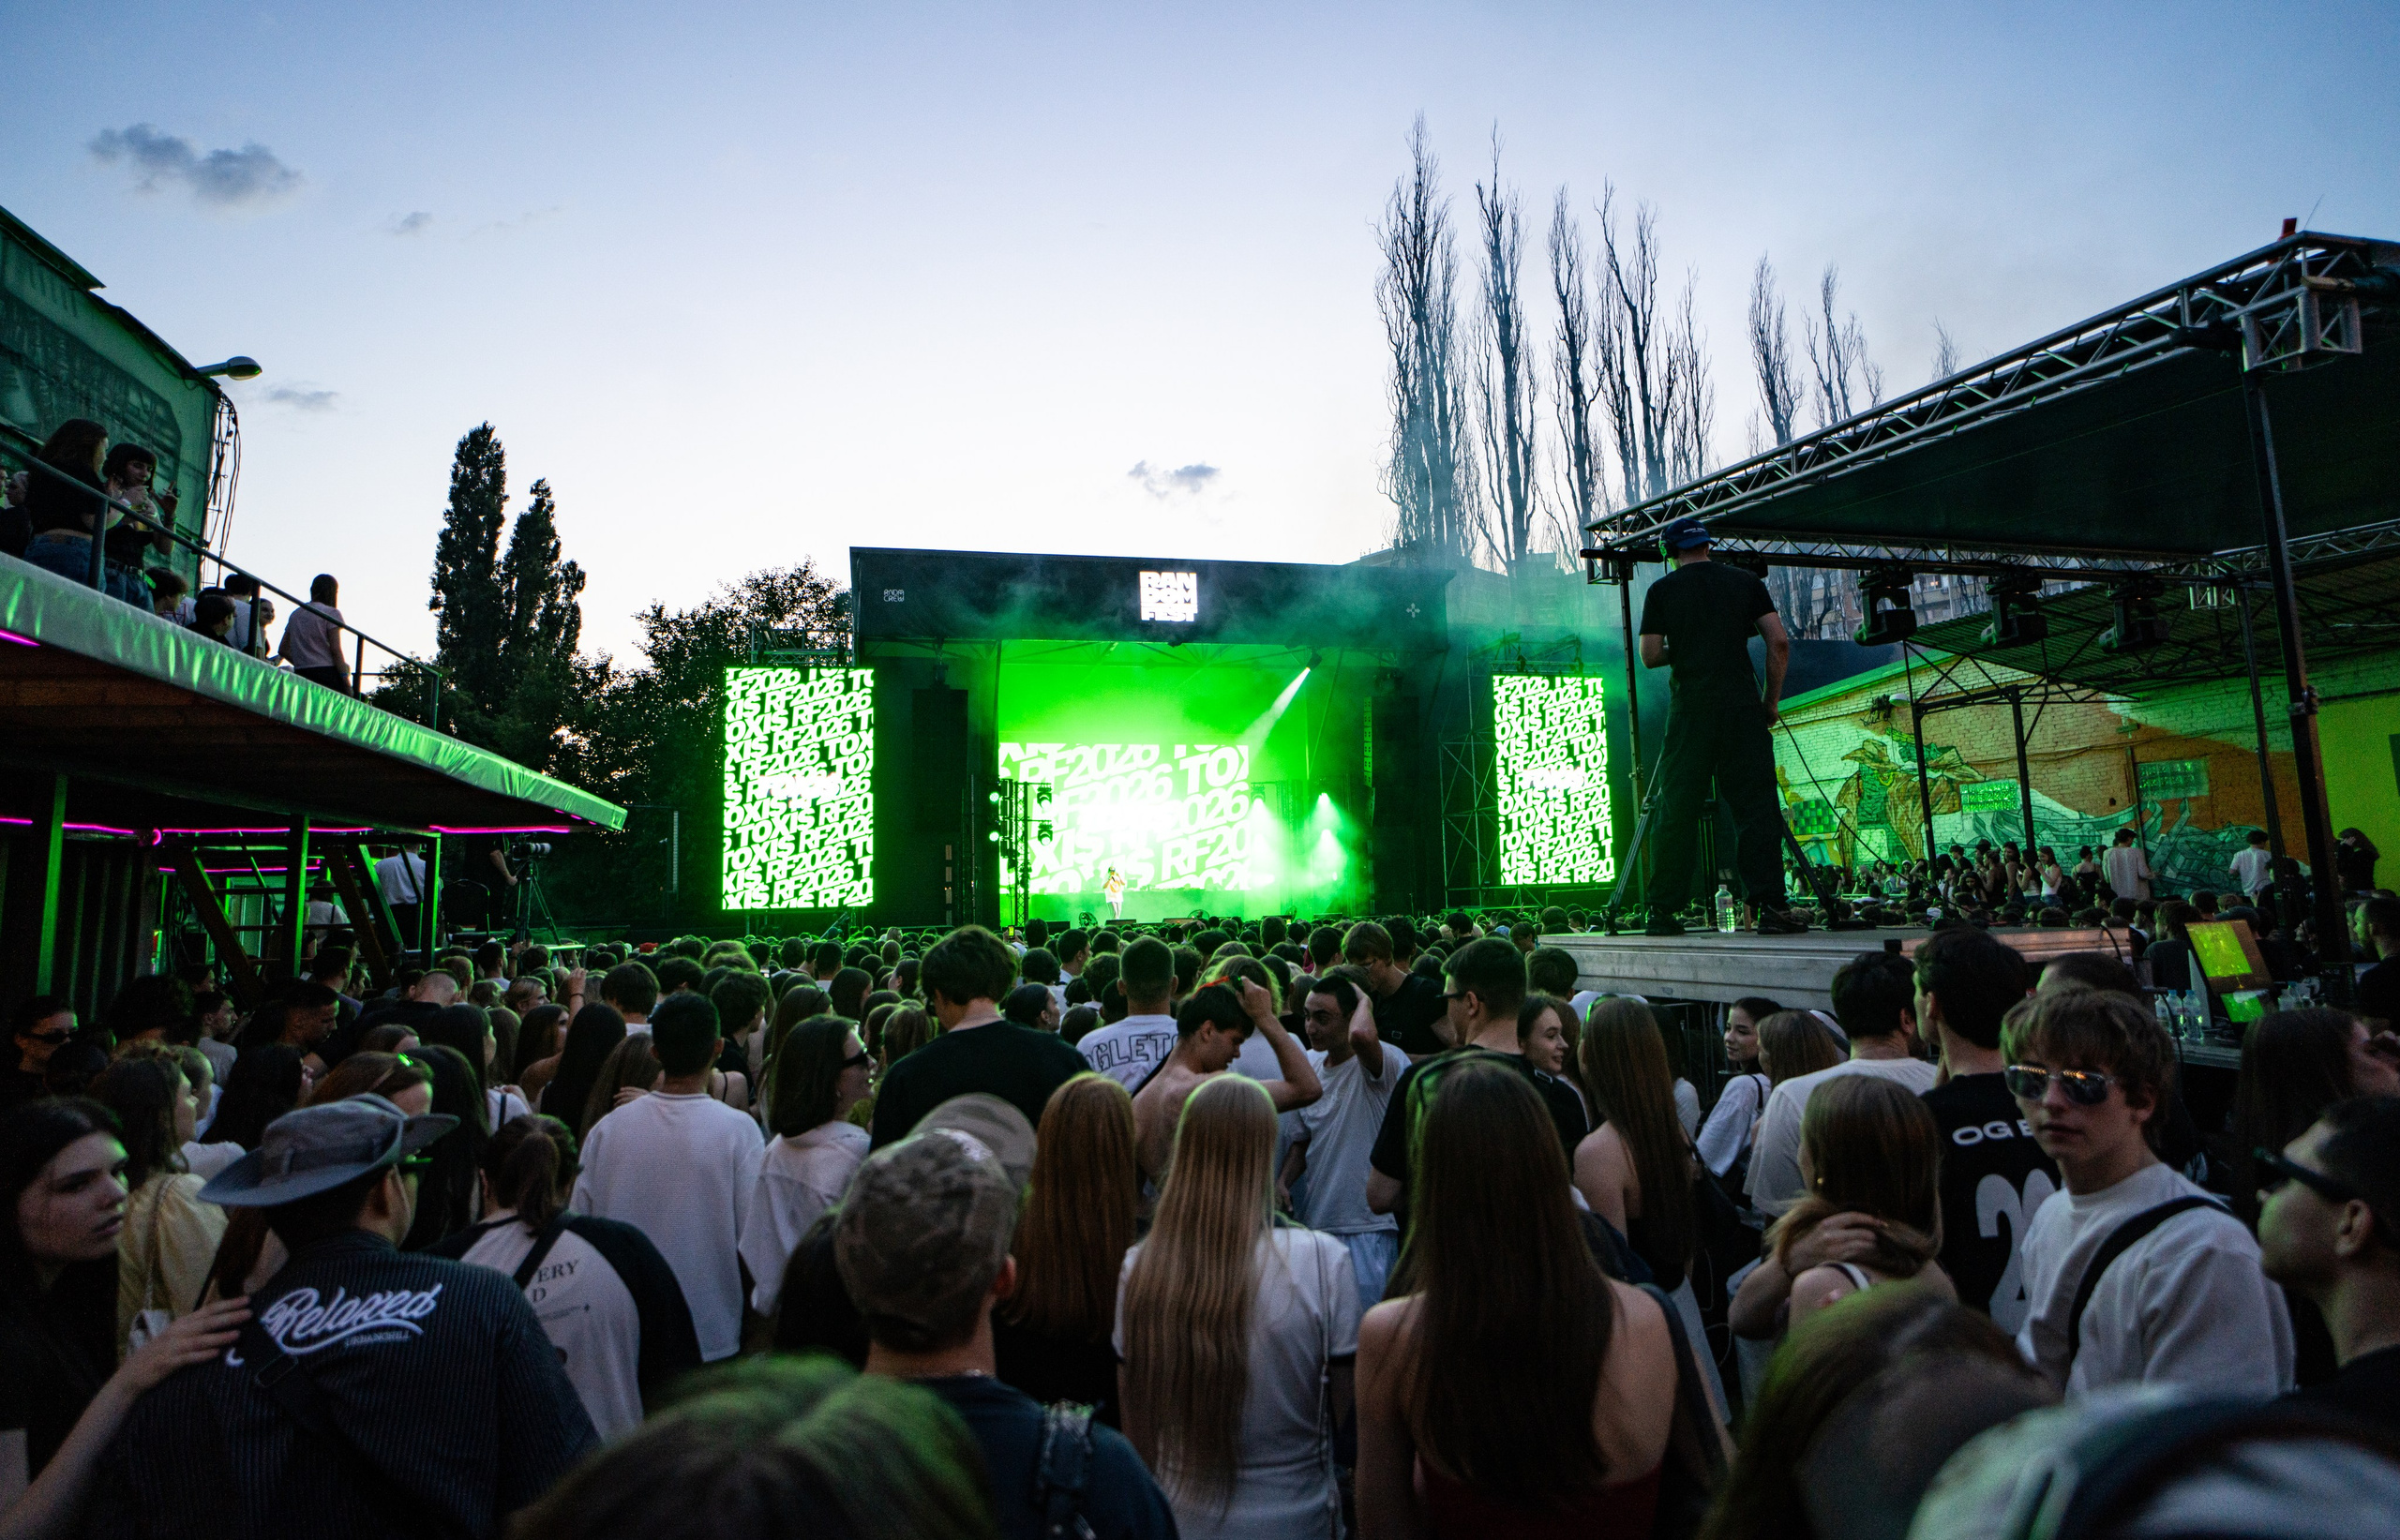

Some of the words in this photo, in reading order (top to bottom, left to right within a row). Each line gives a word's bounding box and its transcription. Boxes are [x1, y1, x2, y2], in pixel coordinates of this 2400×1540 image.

[1139, 571, 1197, 590] RAN
[1140, 588, 1198, 605] DOM
[1141, 605, 1198, 621] FEST
[764, 674, 845, 713] RF2026
[792, 688, 872, 727] RF2026
[1523, 682, 1582, 715] RF2026
[1545, 695, 1603, 727] RF2026
[772, 713, 853, 754] RF2026
[1532, 716, 1590, 751] RF2026
[739, 743, 820, 783] RF2026
[1508, 741, 1568, 776] RF2026
[736, 808, 816, 847] TOXIS
[818, 792, 874, 827] RF20
[1508, 797, 1568, 831] TOXIS
[1570, 784, 1611, 814] RF20
[1533, 827, 1593, 862] RF2026
[1539, 843, 1599, 879] RF2026
[766, 842, 848, 884] RF2026
[1574, 857, 1614, 883] RF20
[772, 861, 854, 903] RF2026
[818, 877, 874, 907] RF20
[1086, 1033, 1178, 1072] GLET
[1952, 1120, 2014, 1145] OG
[538, 1259, 580, 1282] ERY
[260, 1282, 443, 1342] Relaxed
